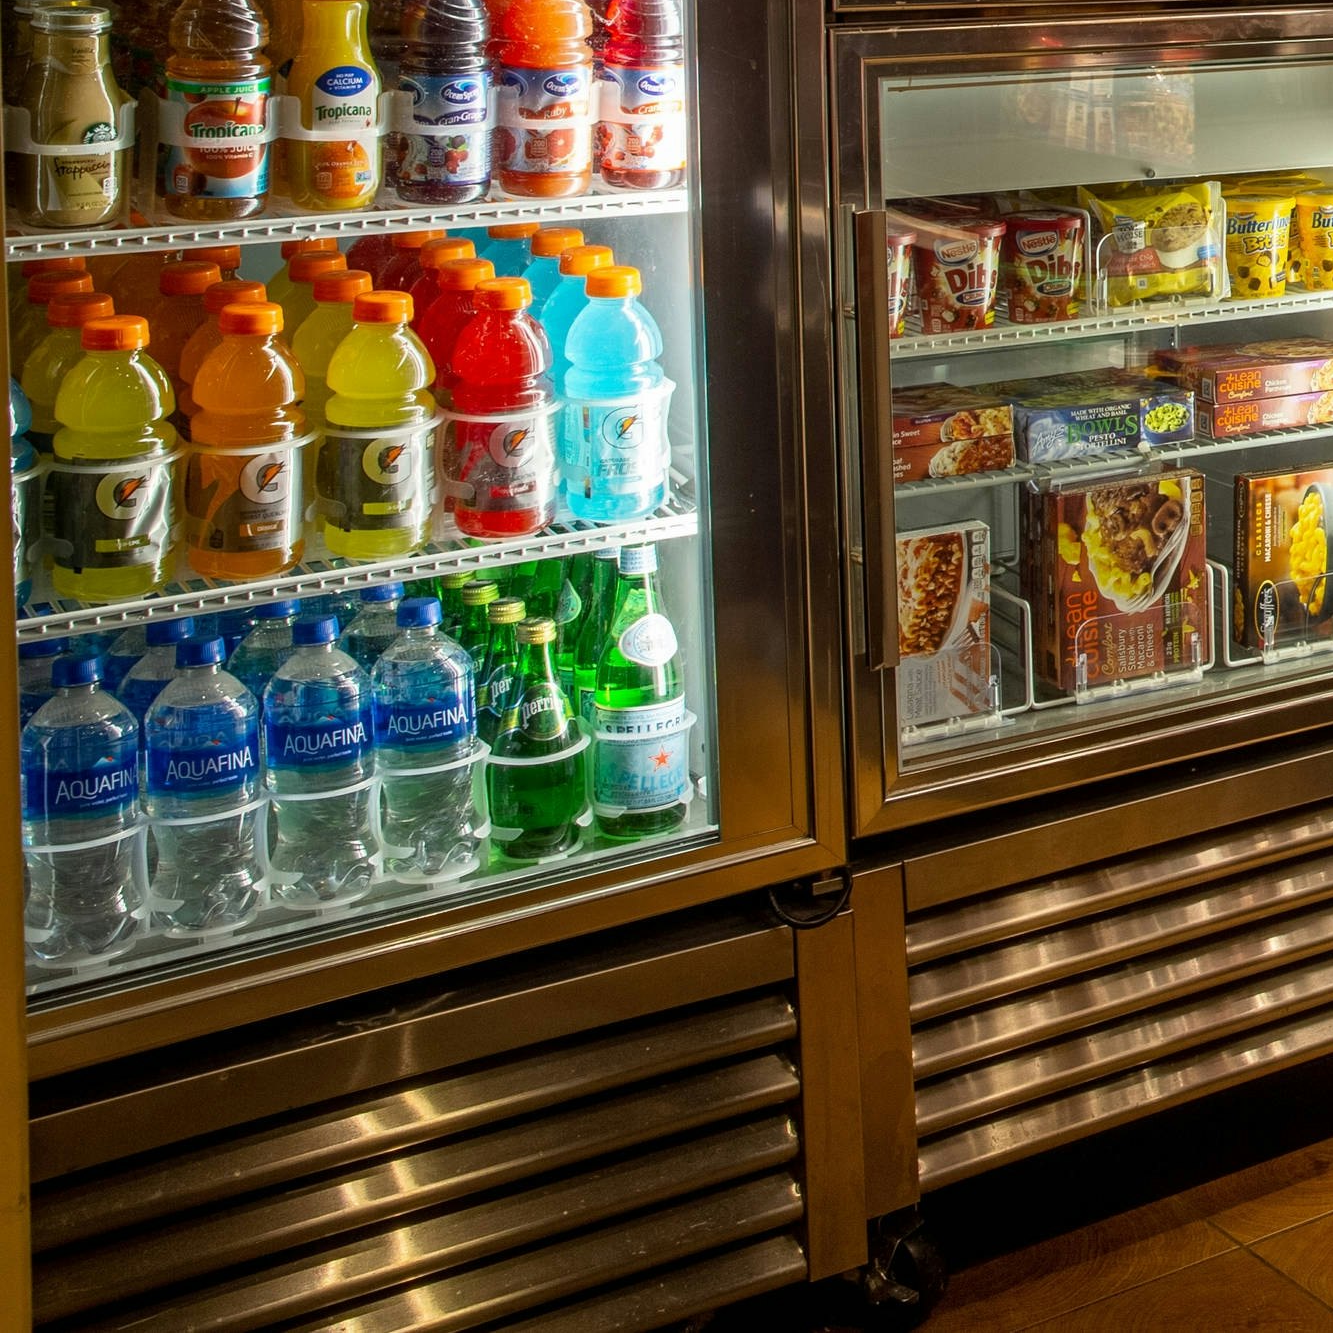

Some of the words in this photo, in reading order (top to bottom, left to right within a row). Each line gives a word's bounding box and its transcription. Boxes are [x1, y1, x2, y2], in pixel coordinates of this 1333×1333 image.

[326, 77, 363, 86] CALCIUM
[315, 105, 372, 120] Tropicana
[949, 268, 998, 292] Dibs
[1027, 256, 1081, 283] Dibs
[1067, 414, 1138, 444] BOWLS
[1089, 433, 1115, 441] PESTO
[1118, 629, 1127, 673] Salisbury
[1128, 643, 1137, 671] Steak
[387, 706, 468, 735] AQUAFINA
[283, 726, 367, 756] AQUAFINA
[166, 746, 253, 781] AQUAFINA
